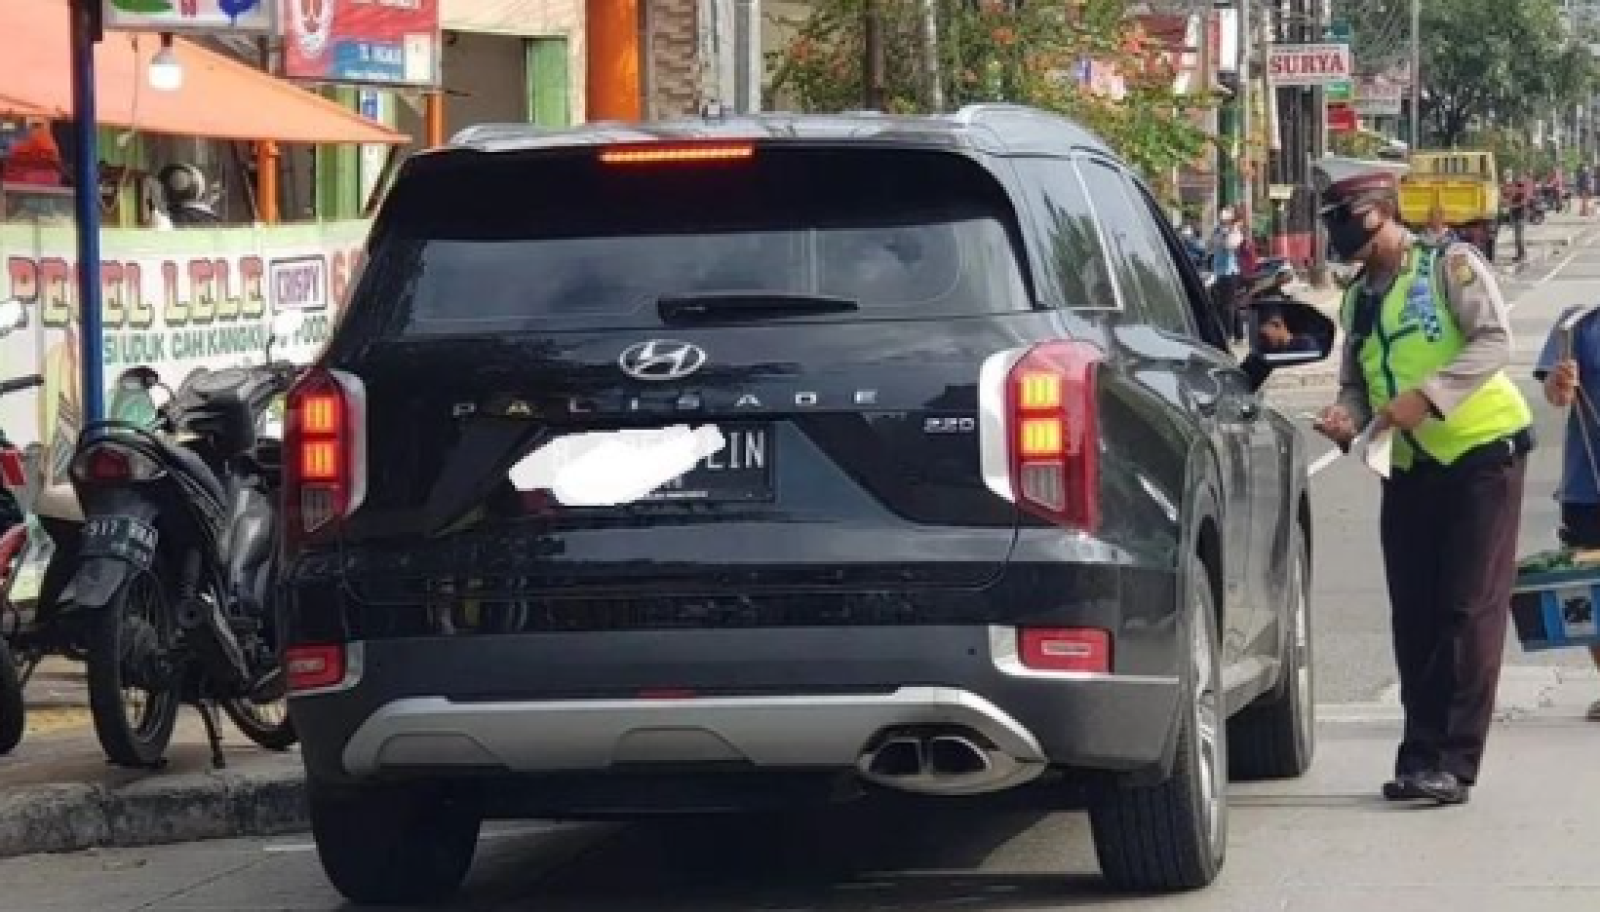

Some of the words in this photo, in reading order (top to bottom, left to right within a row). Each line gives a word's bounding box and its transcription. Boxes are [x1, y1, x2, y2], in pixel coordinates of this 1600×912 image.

[1268, 51, 1346, 74] SURYA
[7, 256, 154, 330] PEEL
[161, 255, 264, 328] LELE
[171, 326, 207, 360] CAH
[452, 390, 879, 418] PALISADE
